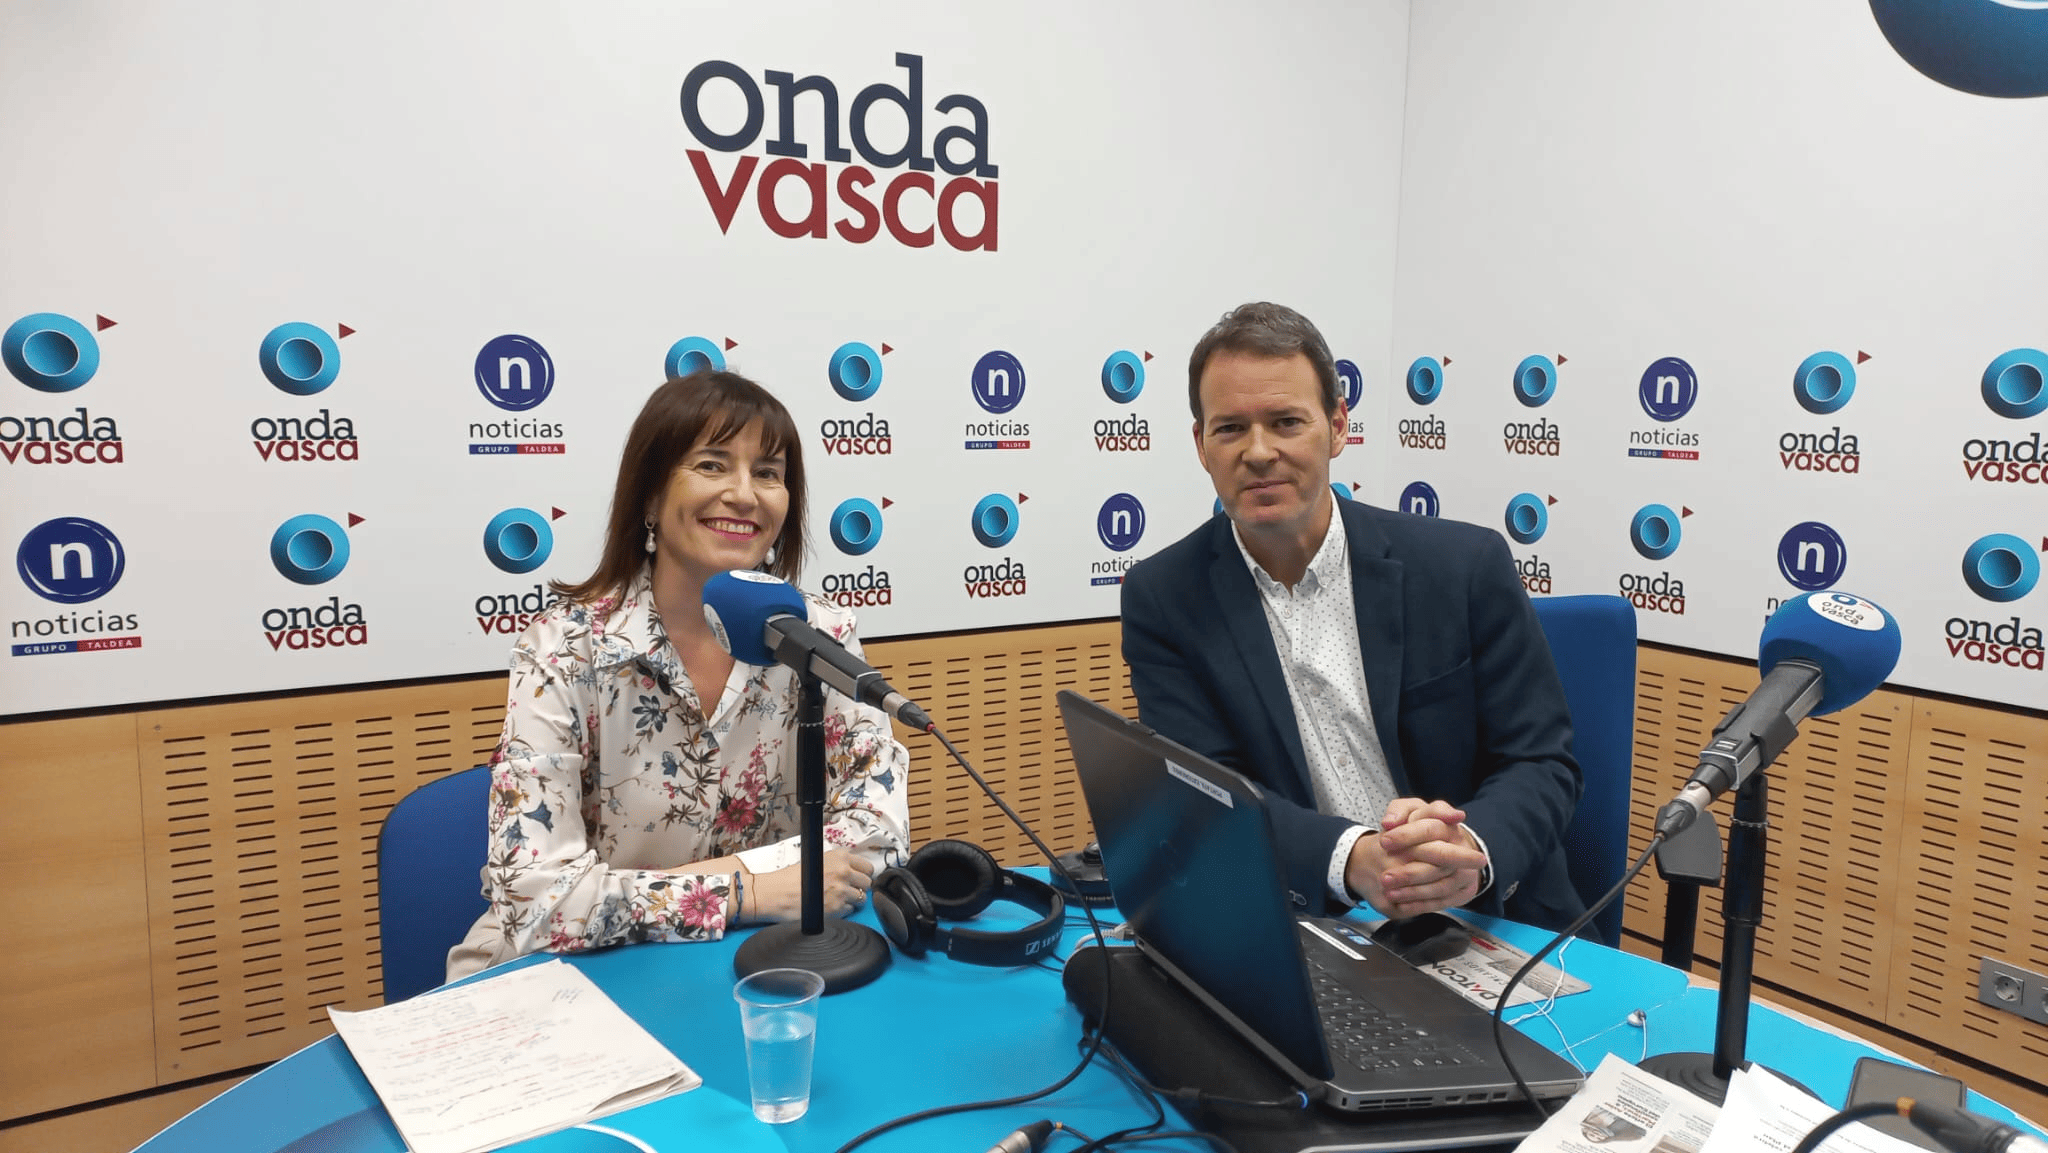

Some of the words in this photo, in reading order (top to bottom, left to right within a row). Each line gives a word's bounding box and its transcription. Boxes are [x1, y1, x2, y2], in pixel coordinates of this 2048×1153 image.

[680, 52, 998, 179] onda
[685, 149, 998, 252] vasca
[499, 357, 531, 389] n
[988, 369, 1009, 396] n
[1655, 375, 1680, 404] n
[0, 407, 121, 442] onda
[251, 409, 357, 441] onda
[469, 418, 563, 438] noticias
[820, 413, 891, 439] onda
[965, 419, 1030, 436] noticias
[1094, 413, 1150, 436] onda
[1398, 414, 1446, 436] onda
[1504, 417, 1560, 441] onda
[1630, 427, 1699, 446] noticias
[0, 441, 124, 464] vasca
[253, 440, 359, 462] vasca
[822, 438, 892, 456] vasca
[1095, 435, 1150, 452] vasca
[1400, 433, 1446, 450] vasca
[1504, 438, 1560, 457] vasca
[1779, 427, 1860, 456] onda
[1779, 451, 1860, 474] vasca
[1112, 510, 1131, 535] n
[50, 542, 93, 580] n
[1091, 556, 1142, 573] notici
[1513, 555, 1552, 579] nda
[1797, 541, 1825, 573] n
[821, 565, 891, 593] onda
[964, 557, 1026, 583] onda
[965, 579, 1026, 599] vasca
[1519, 576, 1552, 594] sca
[1619, 571, 1686, 598] onda
[823, 588, 892, 608] vasca
[1619, 590, 1686, 615] vasca
[262, 596, 367, 632] onda
[1822, 601, 1865, 621] onda
[1822, 606, 1859, 625] vasca
[12, 610, 139, 638] noticias
[477, 613, 541, 635] vas
[1945, 617, 2045, 651] onda
[24, 644, 67, 654] GRUPO
[87, 639, 133, 649] TALDEA
[264, 624, 368, 652] vasca
[1946, 638, 2045, 671] vasca
